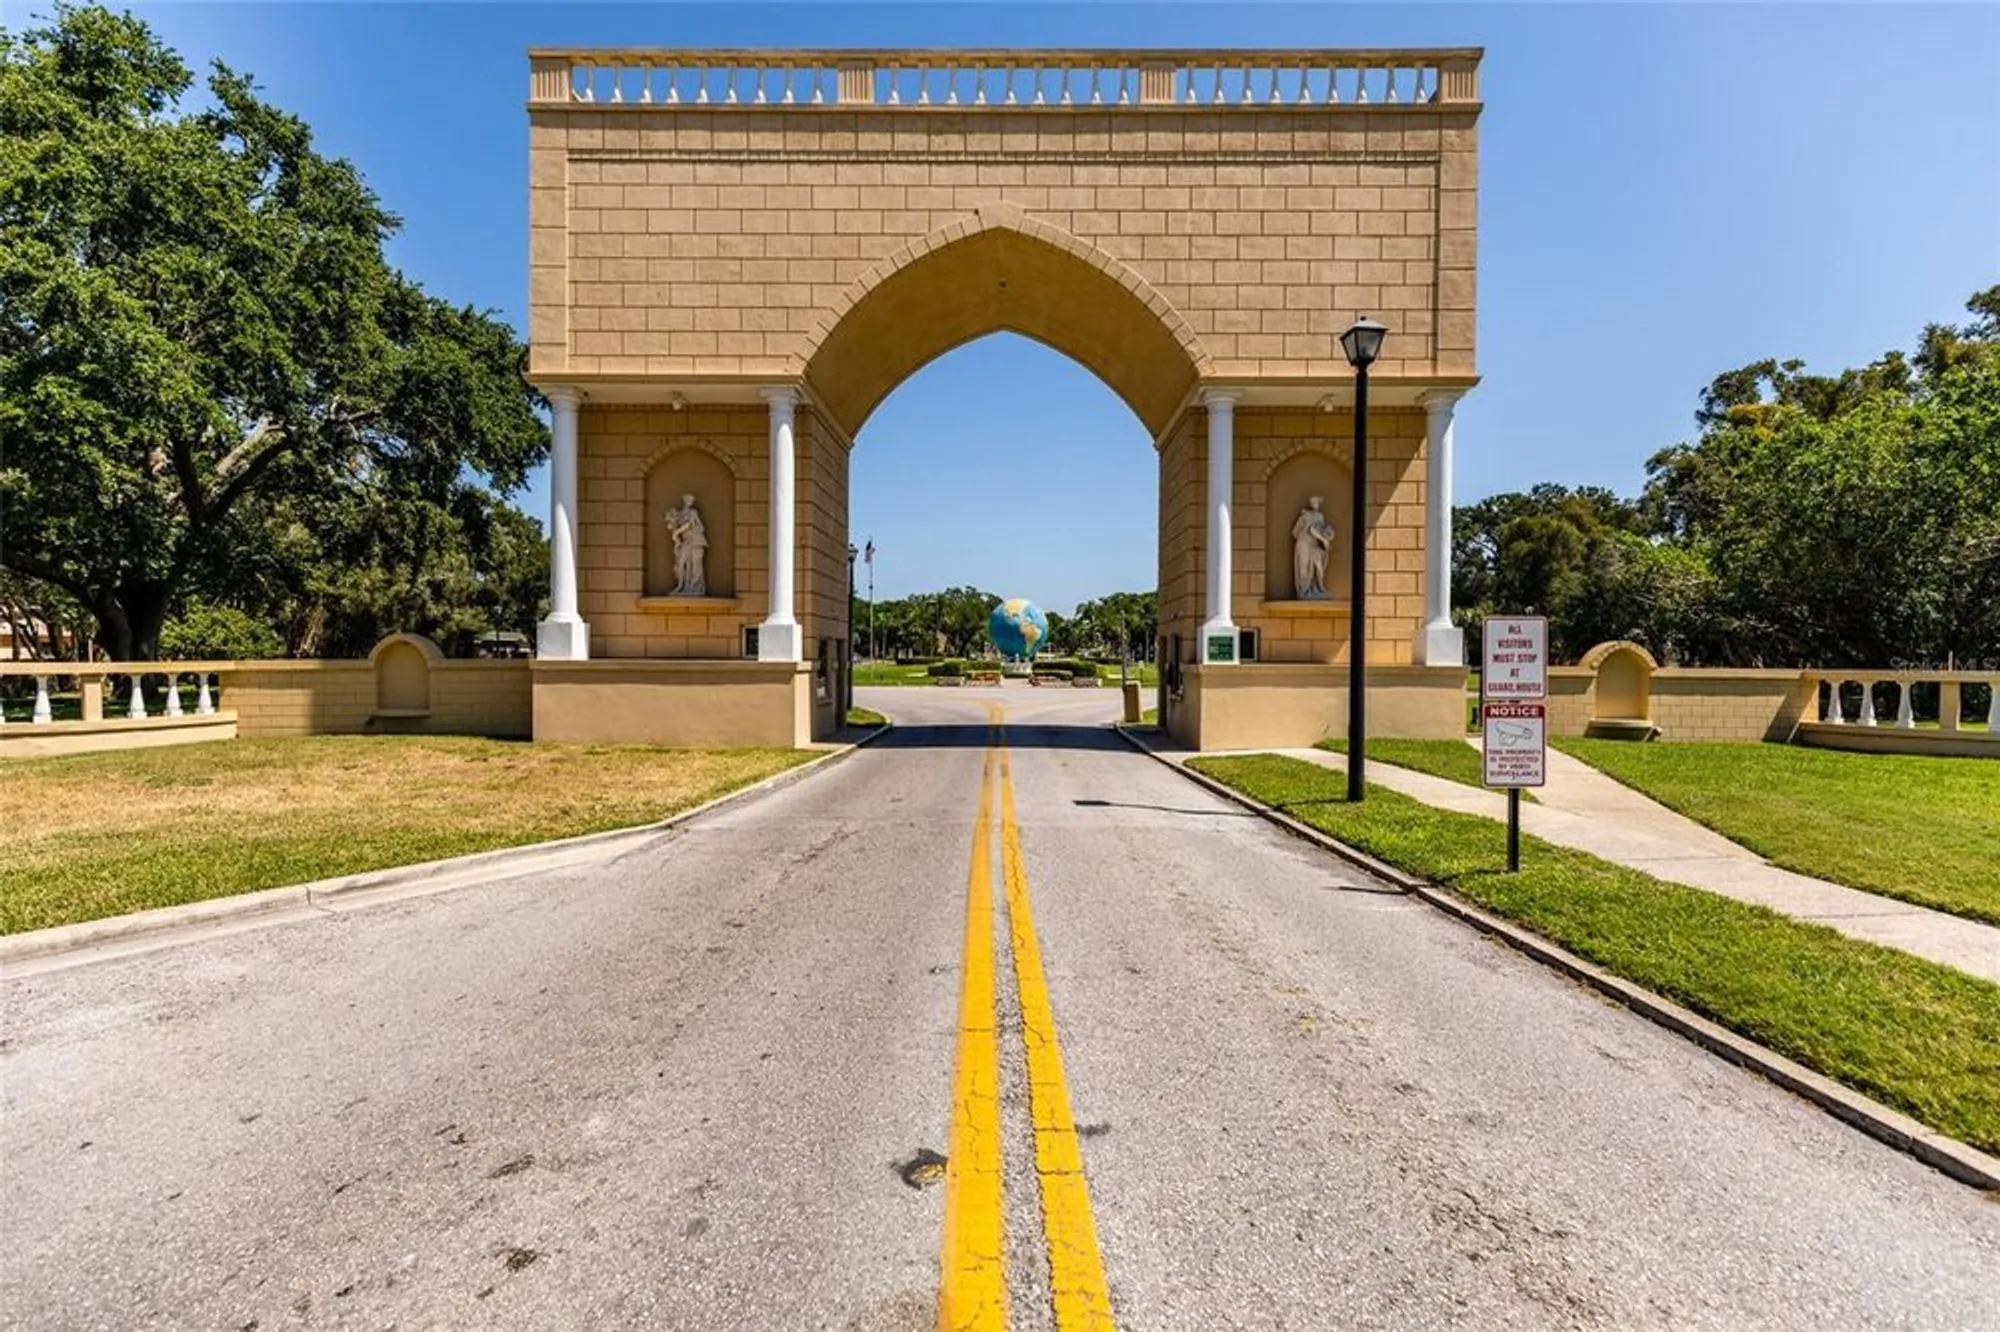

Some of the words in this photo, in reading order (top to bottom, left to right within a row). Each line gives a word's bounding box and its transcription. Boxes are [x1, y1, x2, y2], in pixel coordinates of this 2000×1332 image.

[1508, 625, 1521, 634] ALL
[1498, 640, 1533, 648] VISITORS
[1493, 654, 1515, 663] MUST
[1518, 654, 1537, 663] STOP
[1510, 668, 1520, 677] AT
[1490, 706, 1539, 716] NOTICE
